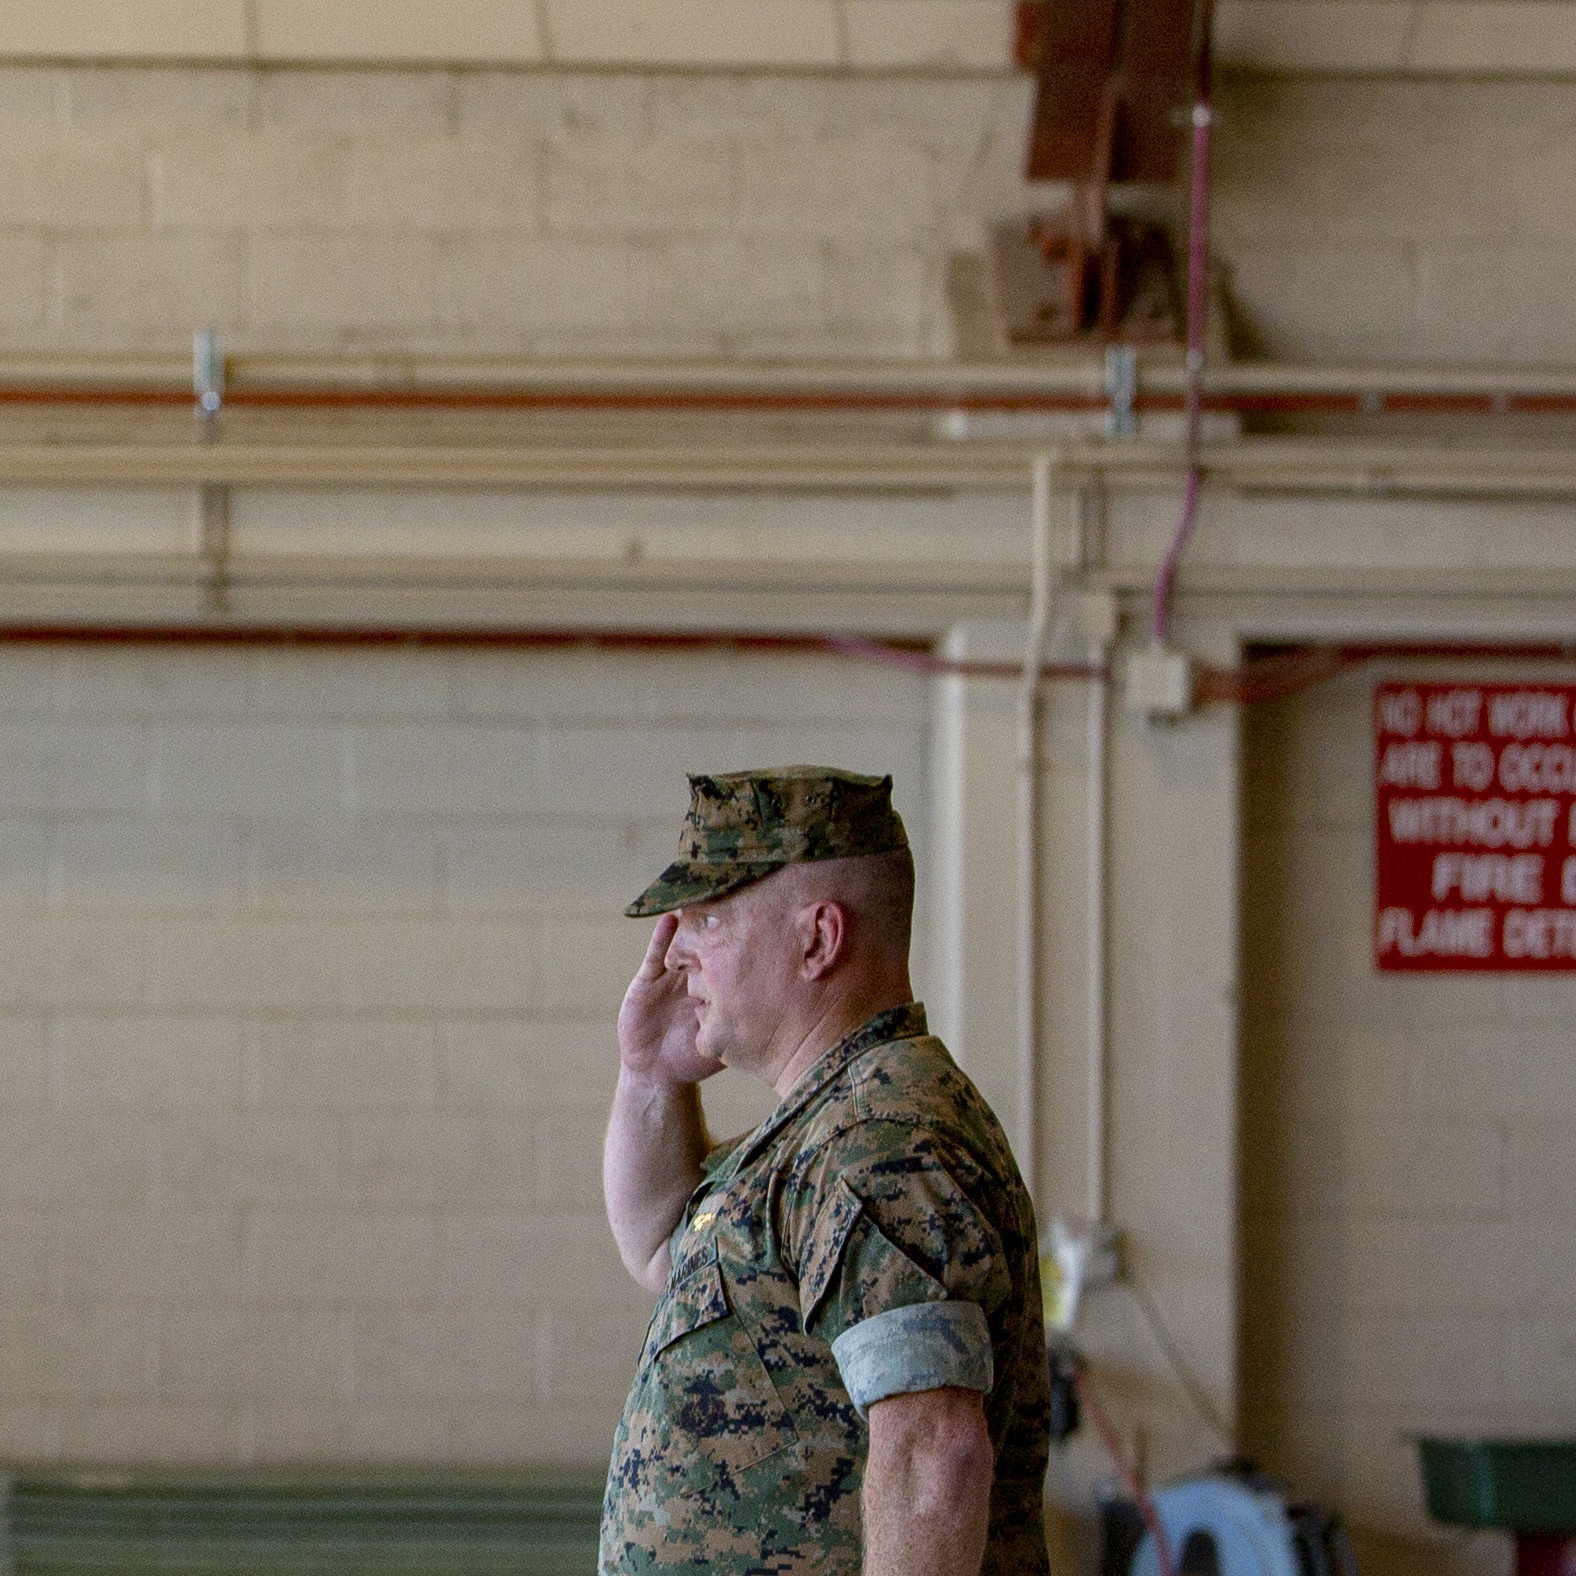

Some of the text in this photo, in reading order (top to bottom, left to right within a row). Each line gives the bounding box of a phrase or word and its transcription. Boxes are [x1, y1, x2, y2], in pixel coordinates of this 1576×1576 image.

[1488, 691, 1569, 738] WORK
[1381, 741, 1442, 790] ARE
[1452, 741, 1495, 791] TO
[1389, 797, 1559, 847] WITHOUT
[1432, 852, 1545, 904] FIRE
